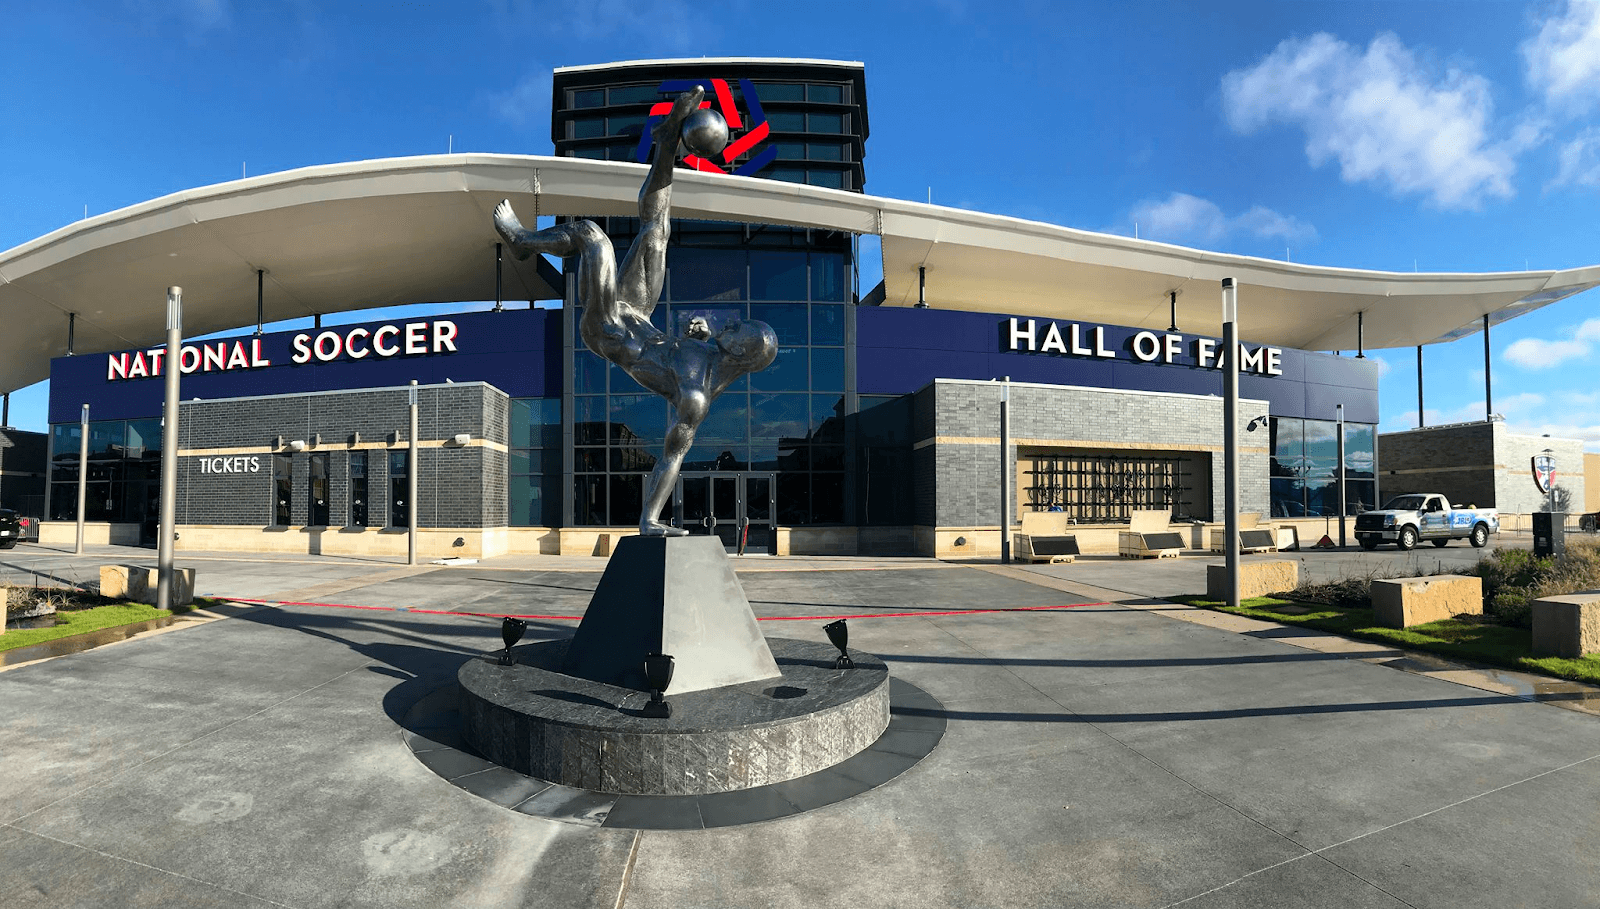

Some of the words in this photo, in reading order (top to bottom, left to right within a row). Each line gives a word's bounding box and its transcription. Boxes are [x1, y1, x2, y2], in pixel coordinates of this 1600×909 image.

[107, 338, 271, 380] NATONAL
[291, 320, 458, 364] SOCCER
[1009, 317, 1116, 358] HALL
[1133, 331, 1183, 363] OF
[1198, 338, 1283, 376] FME
[199, 456, 260, 474] TICKETS
